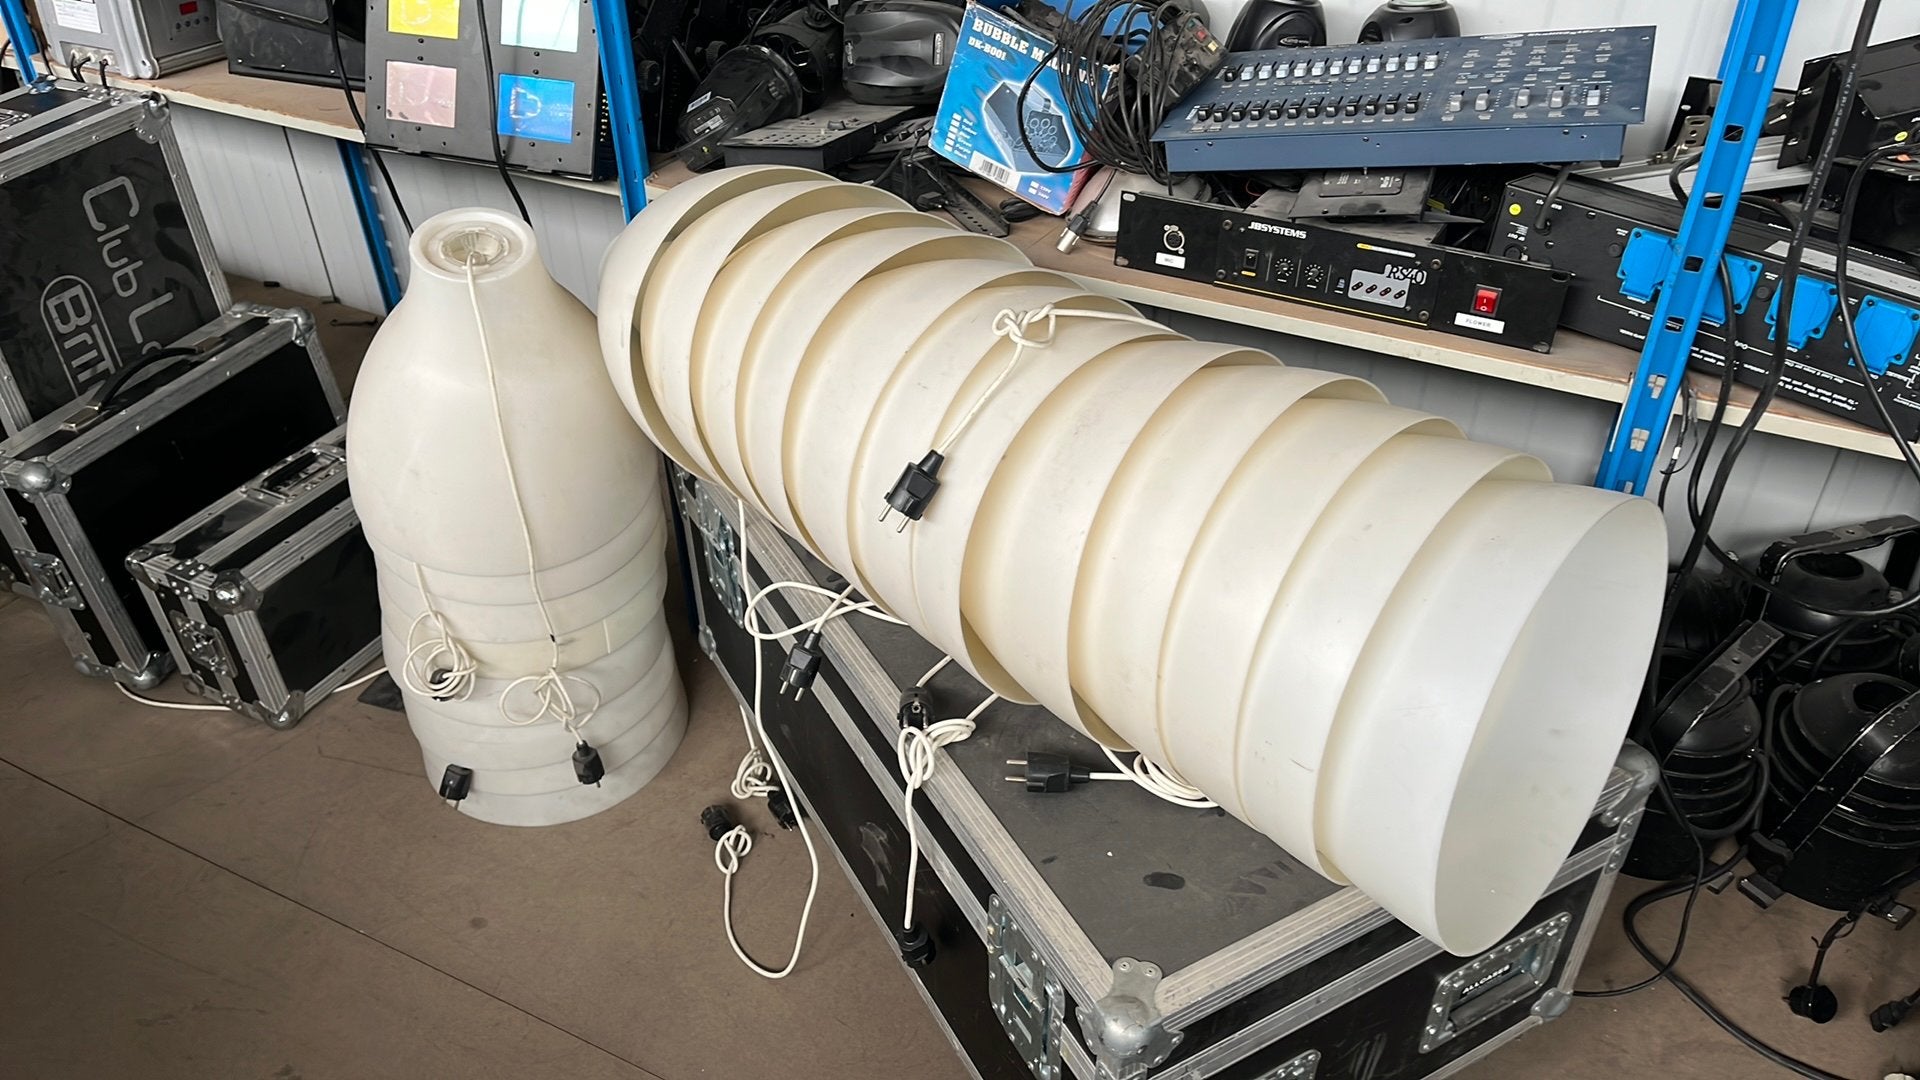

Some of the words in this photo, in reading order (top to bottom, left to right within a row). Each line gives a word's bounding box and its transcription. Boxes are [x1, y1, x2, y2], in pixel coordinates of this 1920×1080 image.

[967, 36, 1007, 60] DK-B001
[972, 17, 1030, 54] BUBBLE
[82, 175, 143, 299] Club
[1386, 264, 1427, 286] RS40
